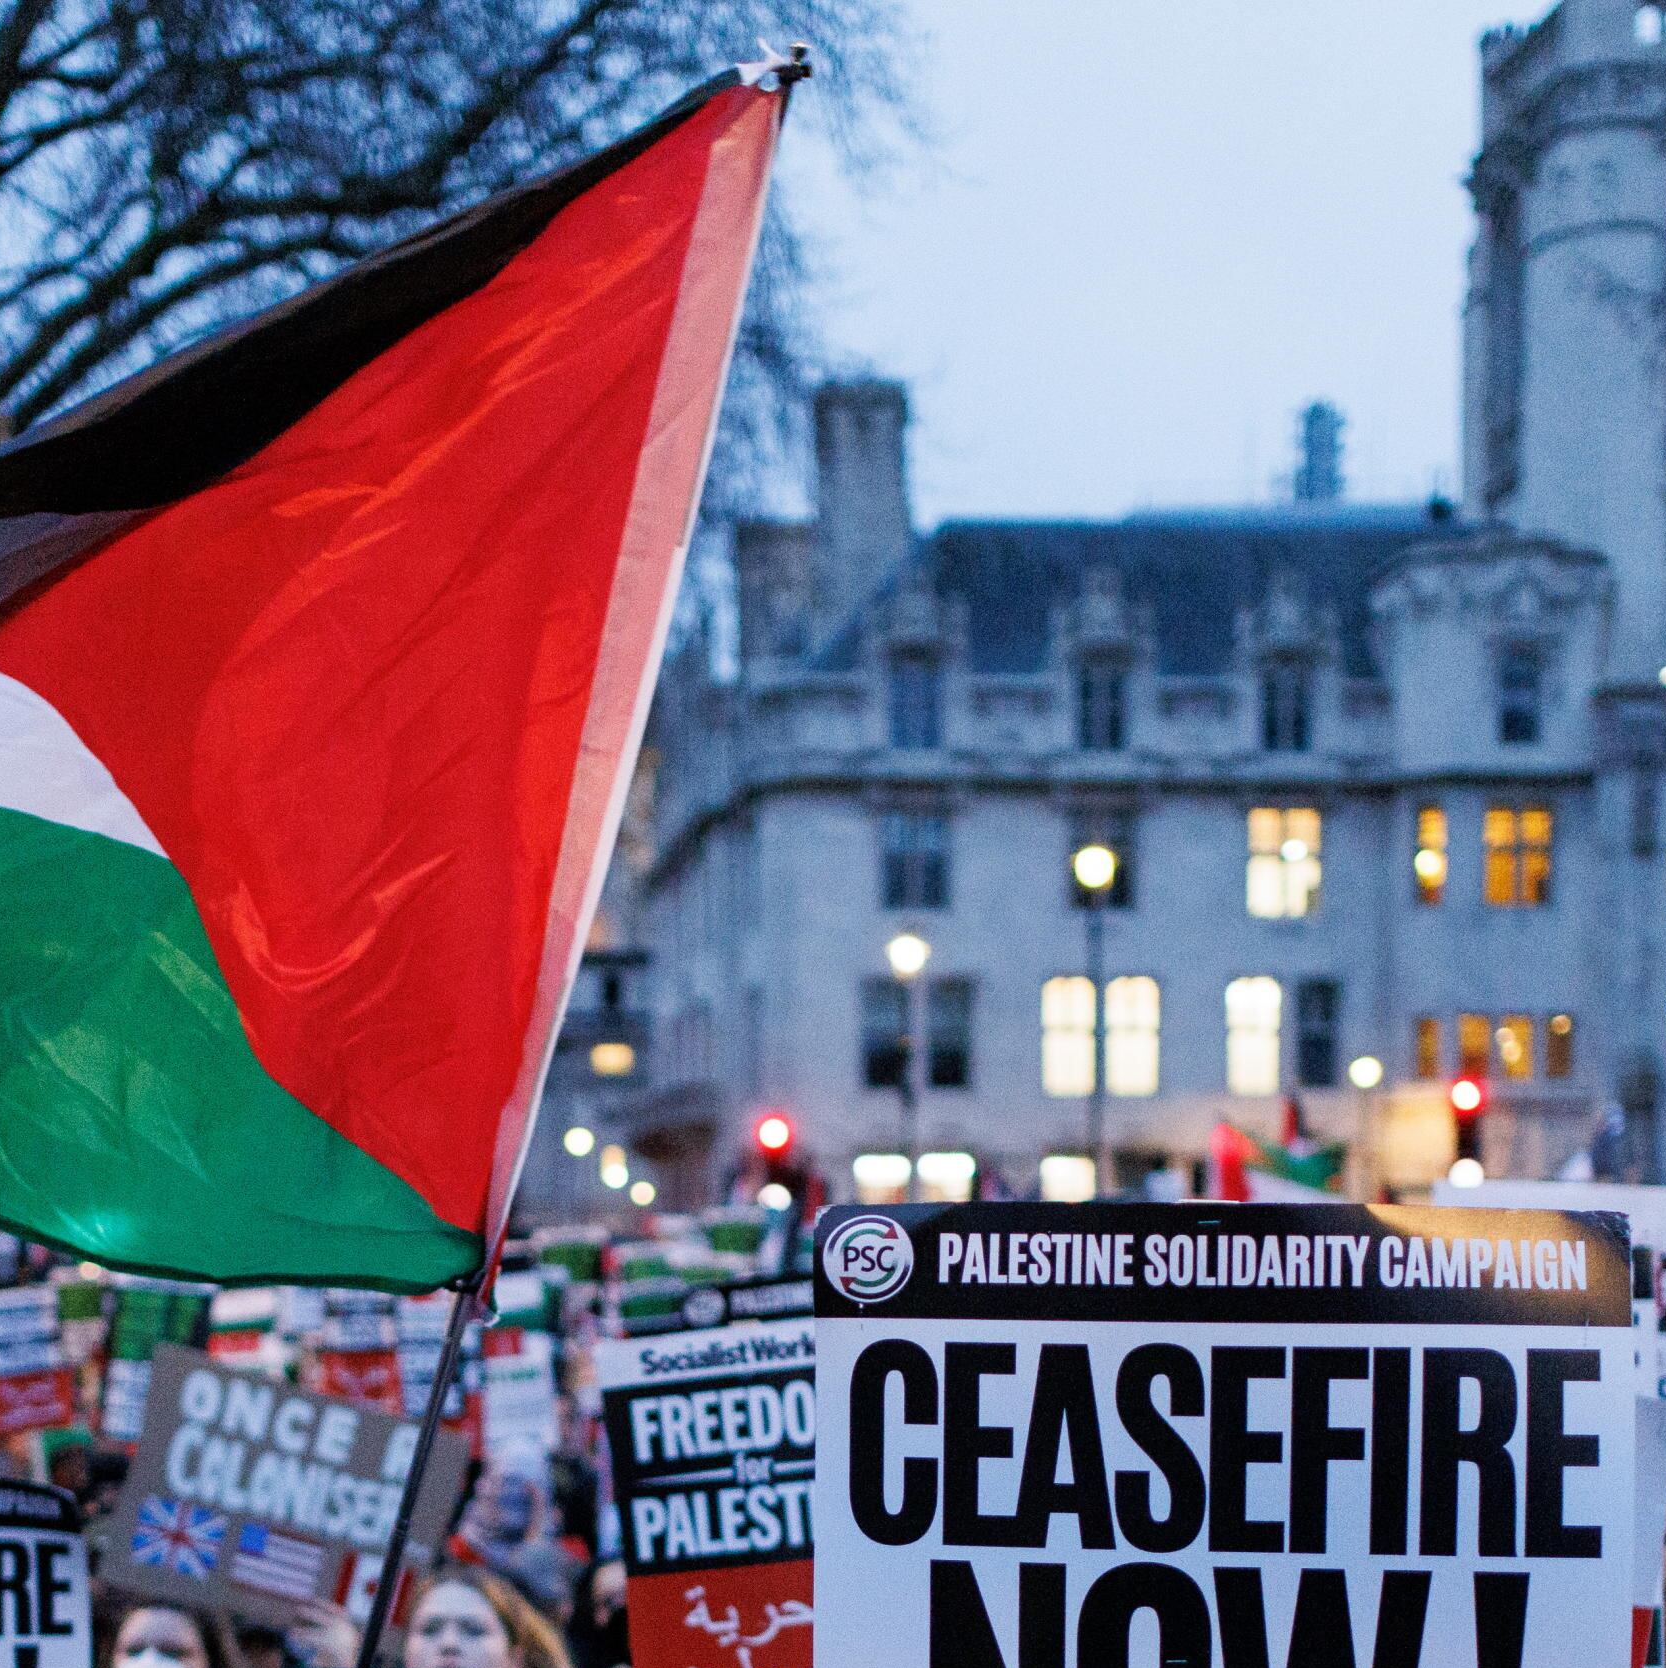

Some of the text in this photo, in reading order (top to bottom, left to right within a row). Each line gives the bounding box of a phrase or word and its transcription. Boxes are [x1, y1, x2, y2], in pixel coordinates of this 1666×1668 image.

[844, 1245, 895, 1273] PSC
[938, 1232, 1588, 1292] PALESTINE SOLIDARITY CAMPAIGN
[182, 1368, 362, 1465] ONCE
[737, 1453, 774, 1484] for
[849, 1338, 1603, 1559] CEASEFIRE
